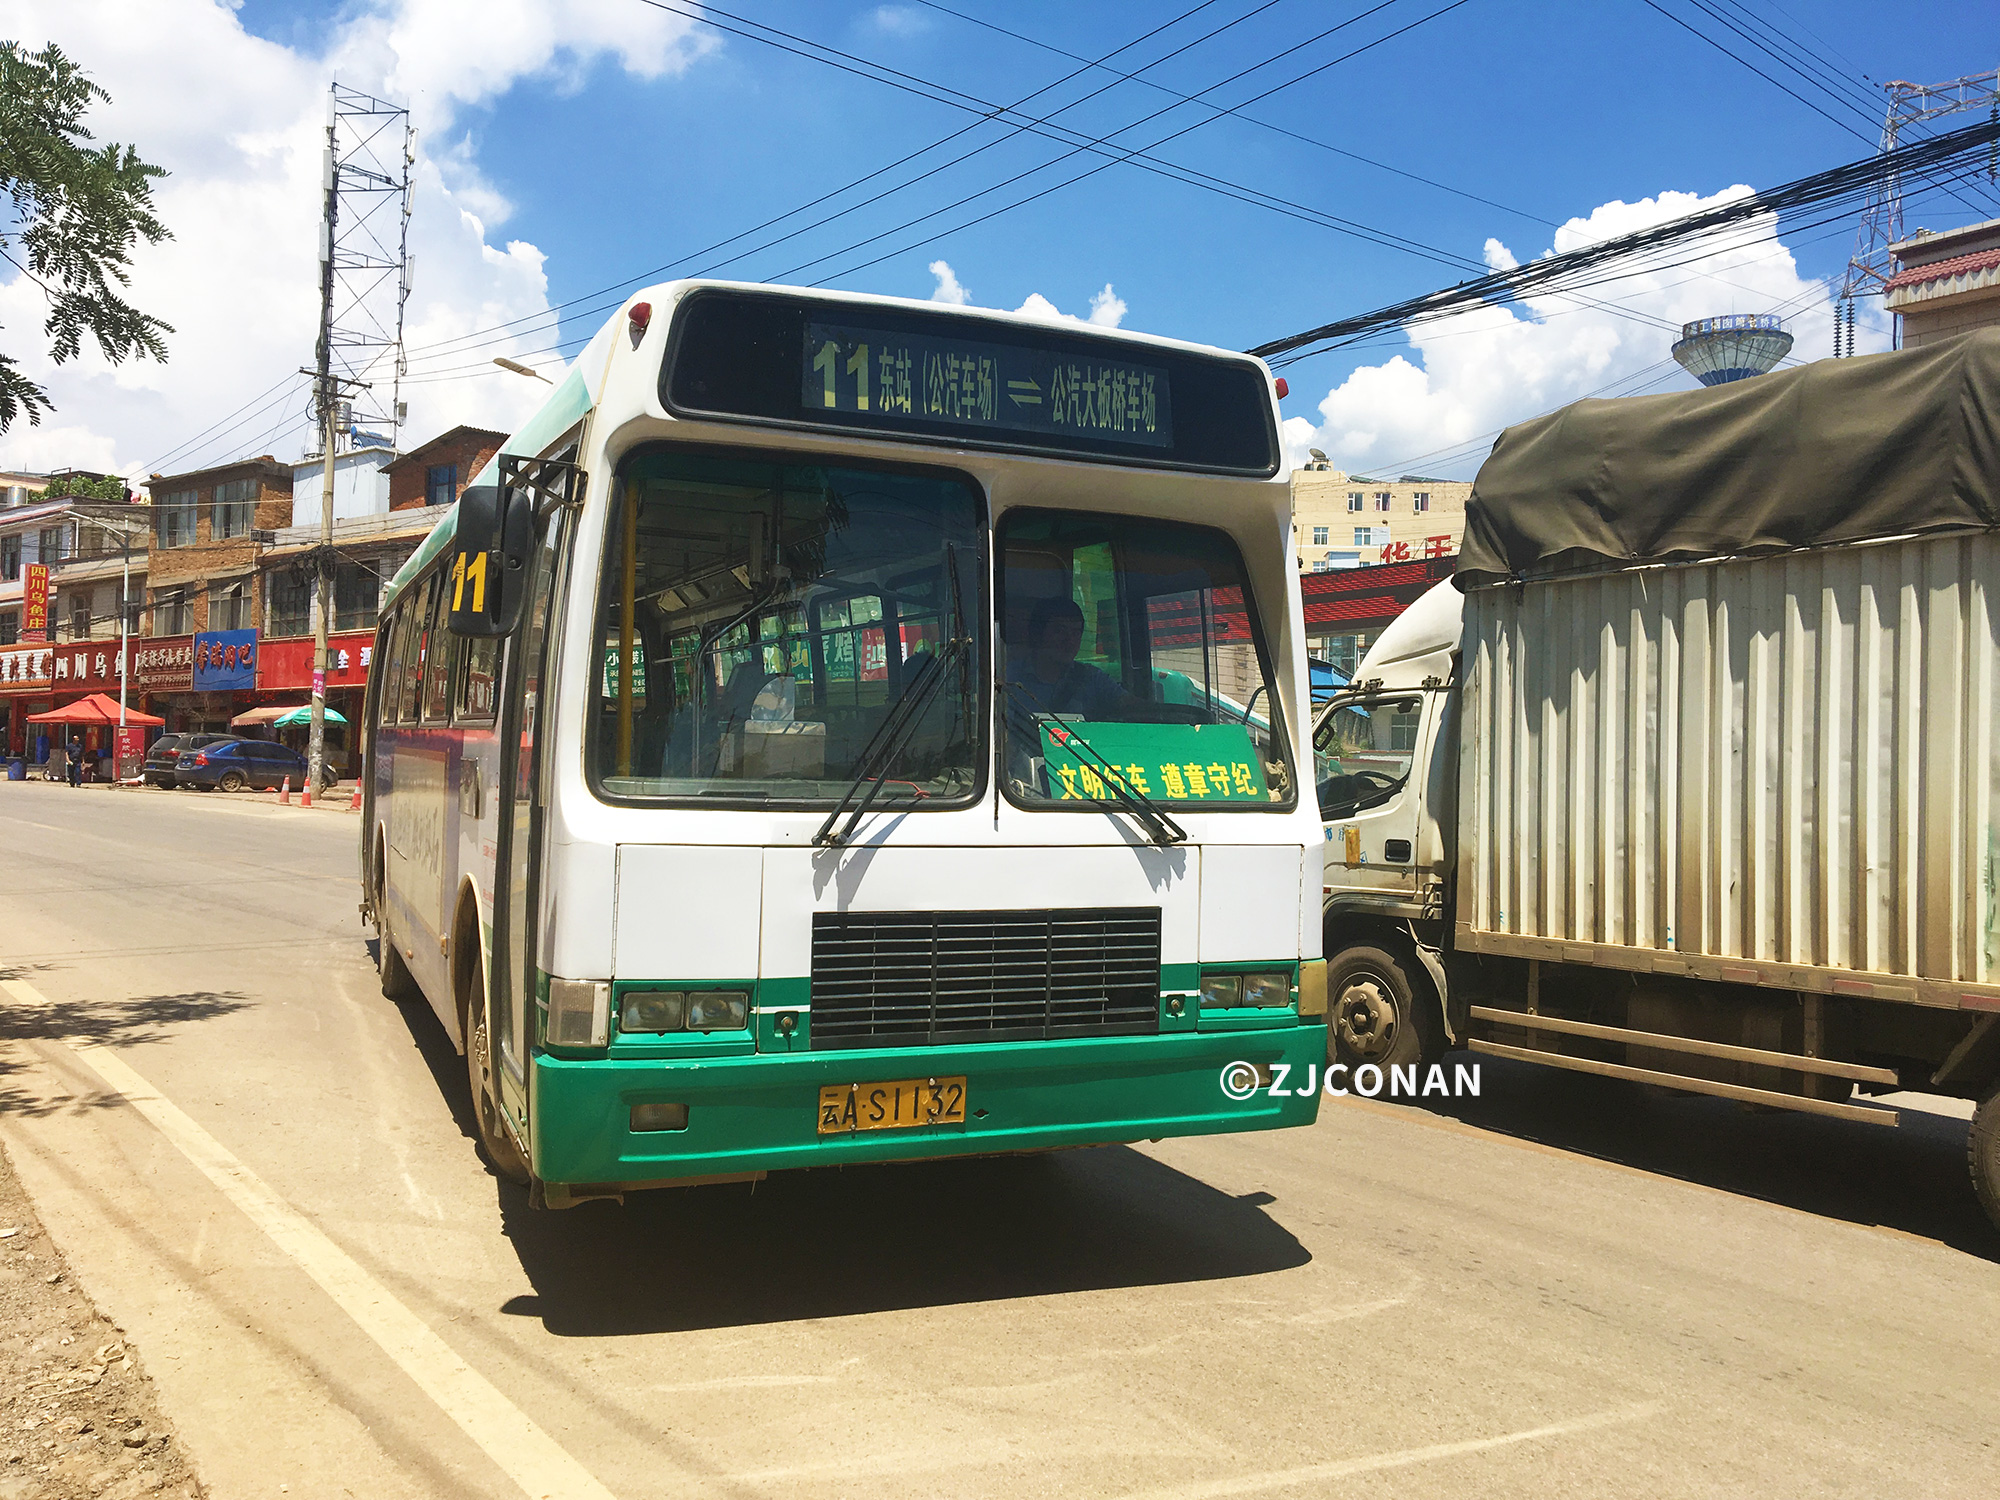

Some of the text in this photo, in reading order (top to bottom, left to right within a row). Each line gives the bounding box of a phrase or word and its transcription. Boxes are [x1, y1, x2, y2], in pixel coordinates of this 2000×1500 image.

[813, 341, 869, 410] 11
[1051, 363, 1155, 432] 公汽大板桥车场
[28, 566, 46, 629] 四川乌鱼庄
[451, 552, 487, 613] 11
[1057, 762, 1257, 800] 文明行车 遵章守纪
